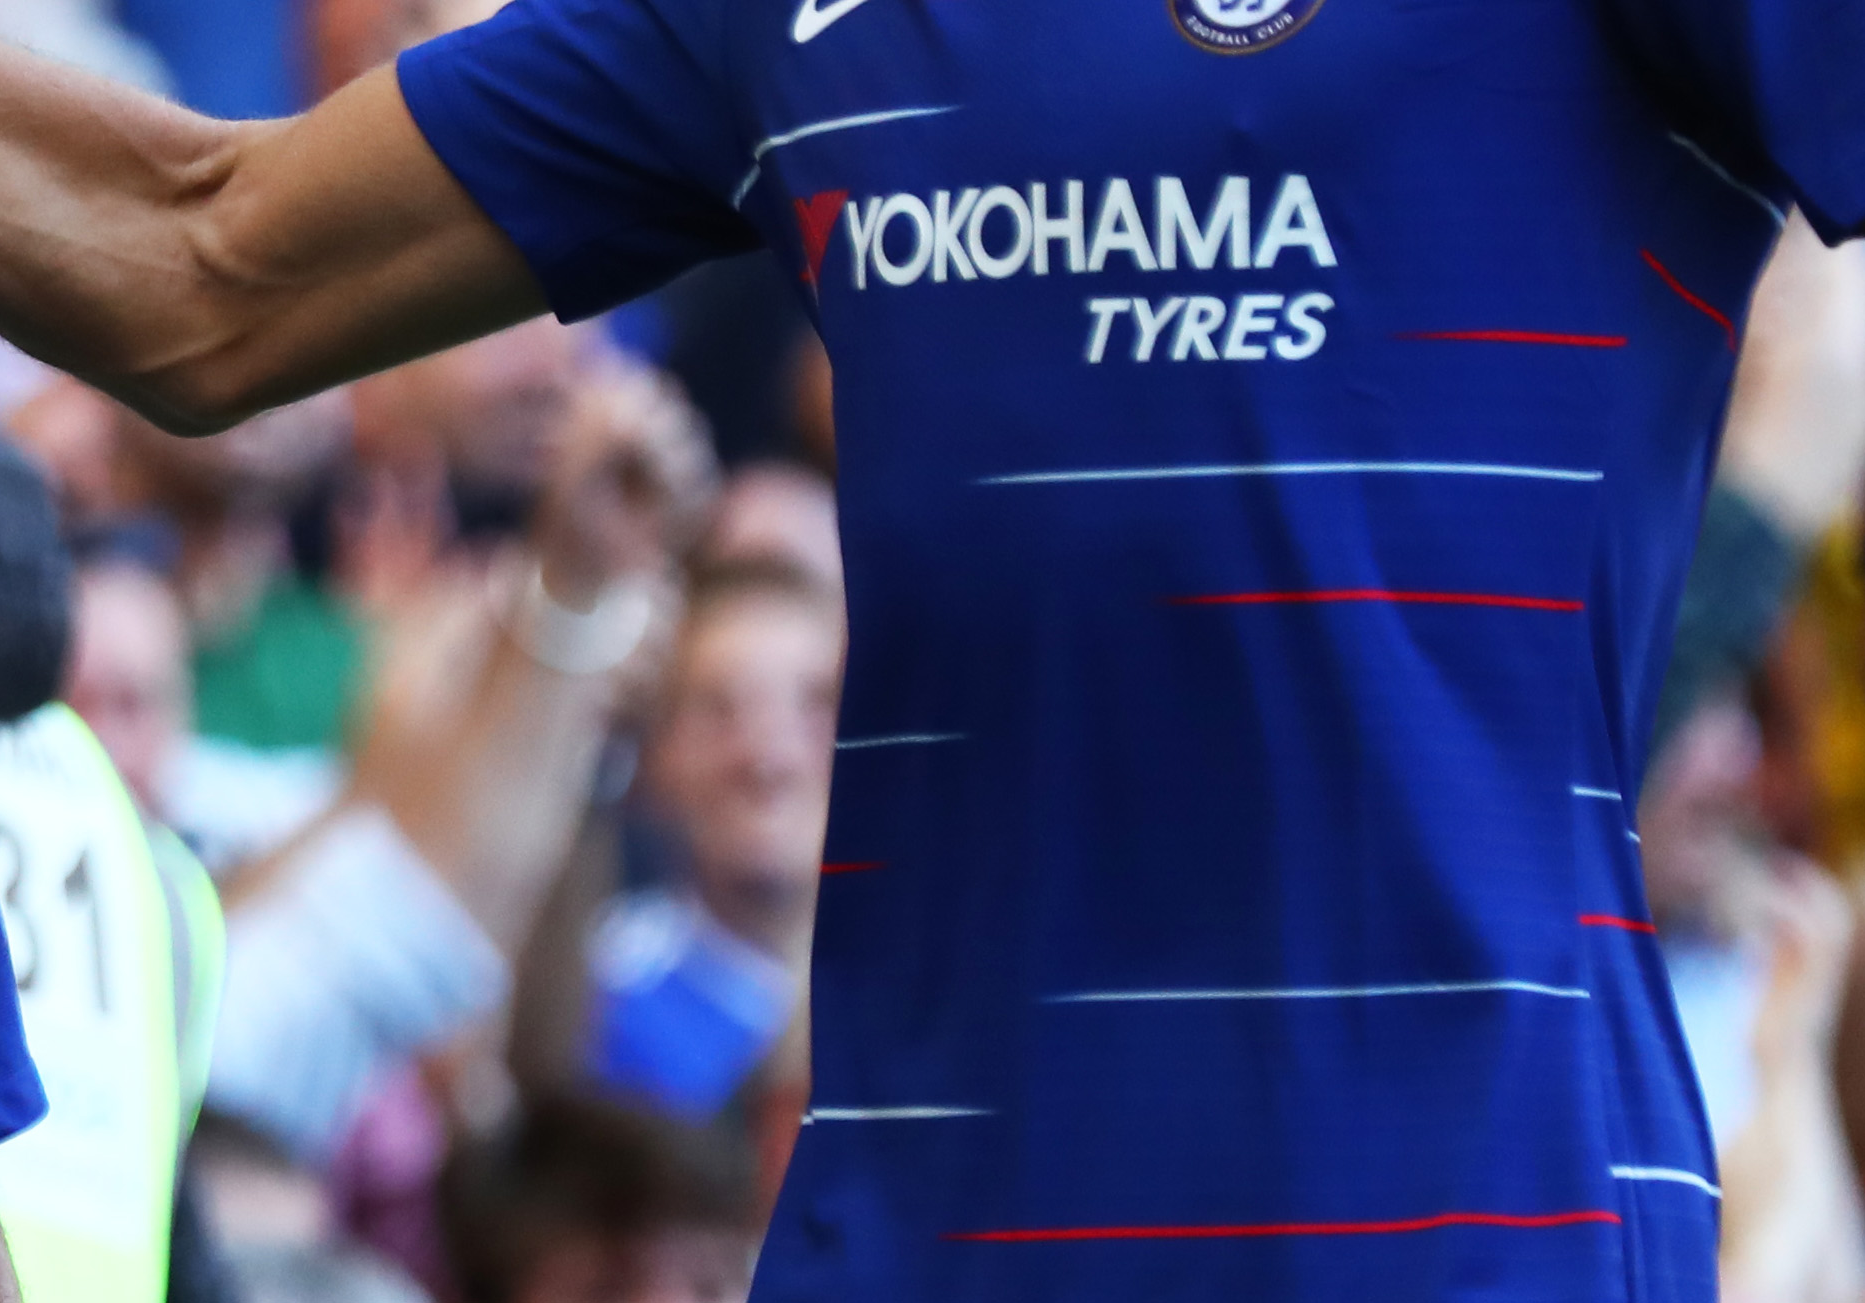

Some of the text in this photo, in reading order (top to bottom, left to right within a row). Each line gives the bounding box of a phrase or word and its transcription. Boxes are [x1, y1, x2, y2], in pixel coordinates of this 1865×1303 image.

[1256, 12, 1294, 40] CLUB
[846, 174, 1338, 290] YOKOHAMA
[1083, 292, 1336, 364] TYRES
